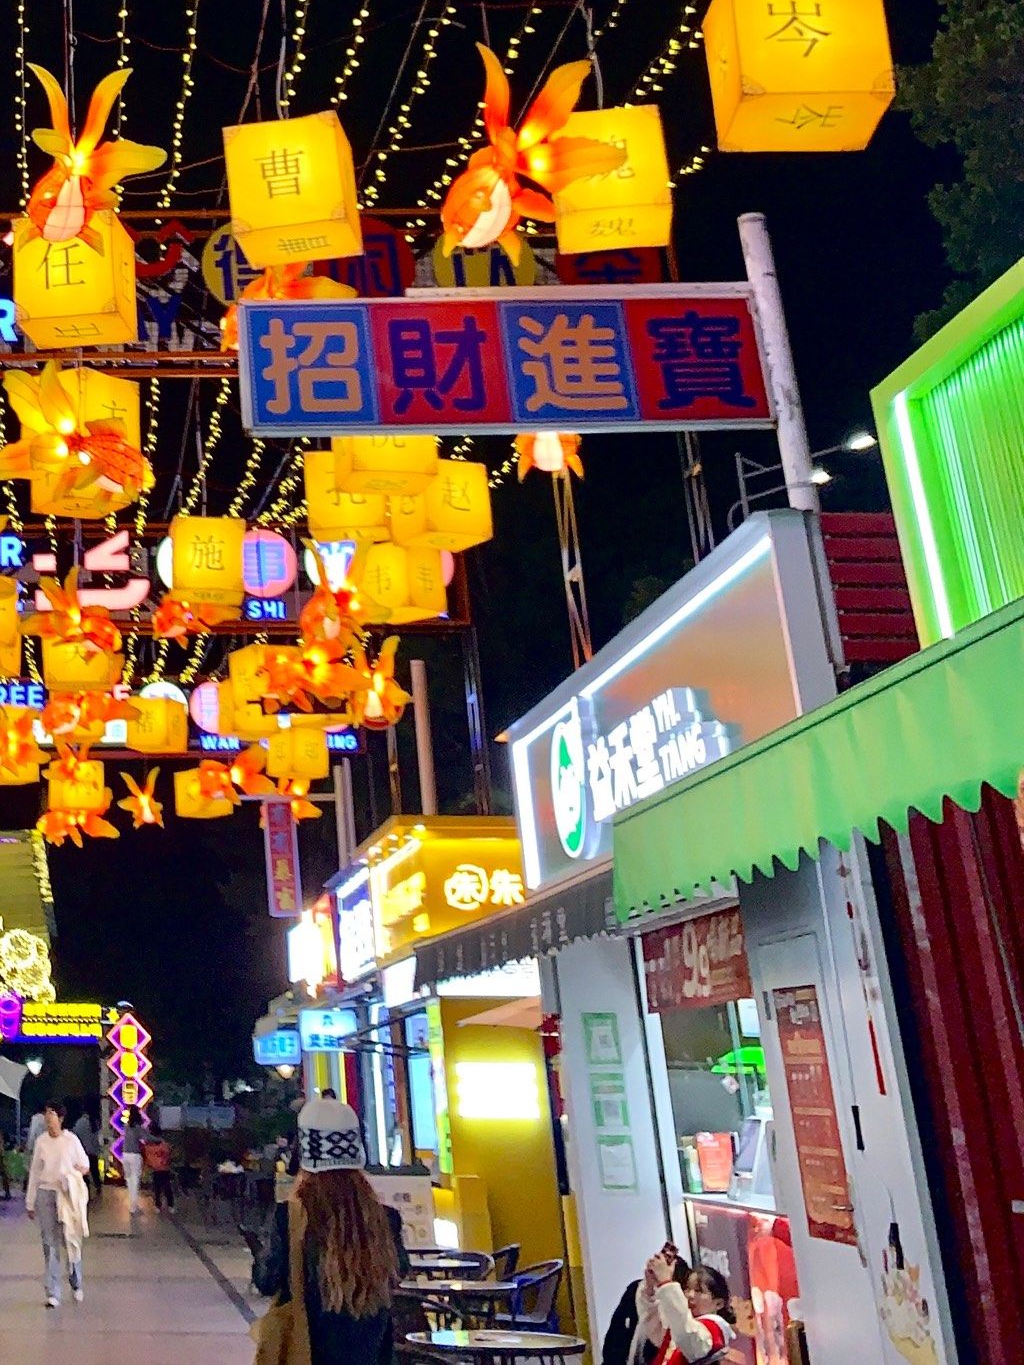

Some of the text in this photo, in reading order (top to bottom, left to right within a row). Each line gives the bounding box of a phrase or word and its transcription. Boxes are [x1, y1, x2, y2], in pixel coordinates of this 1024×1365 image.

[764, 0, 833, 59] 岑
[254, 147, 305, 200] 曹
[36, 241, 87, 292] 任
[258, 308, 757, 417] 招財進寶
[189, 534, 226, 572] 施
